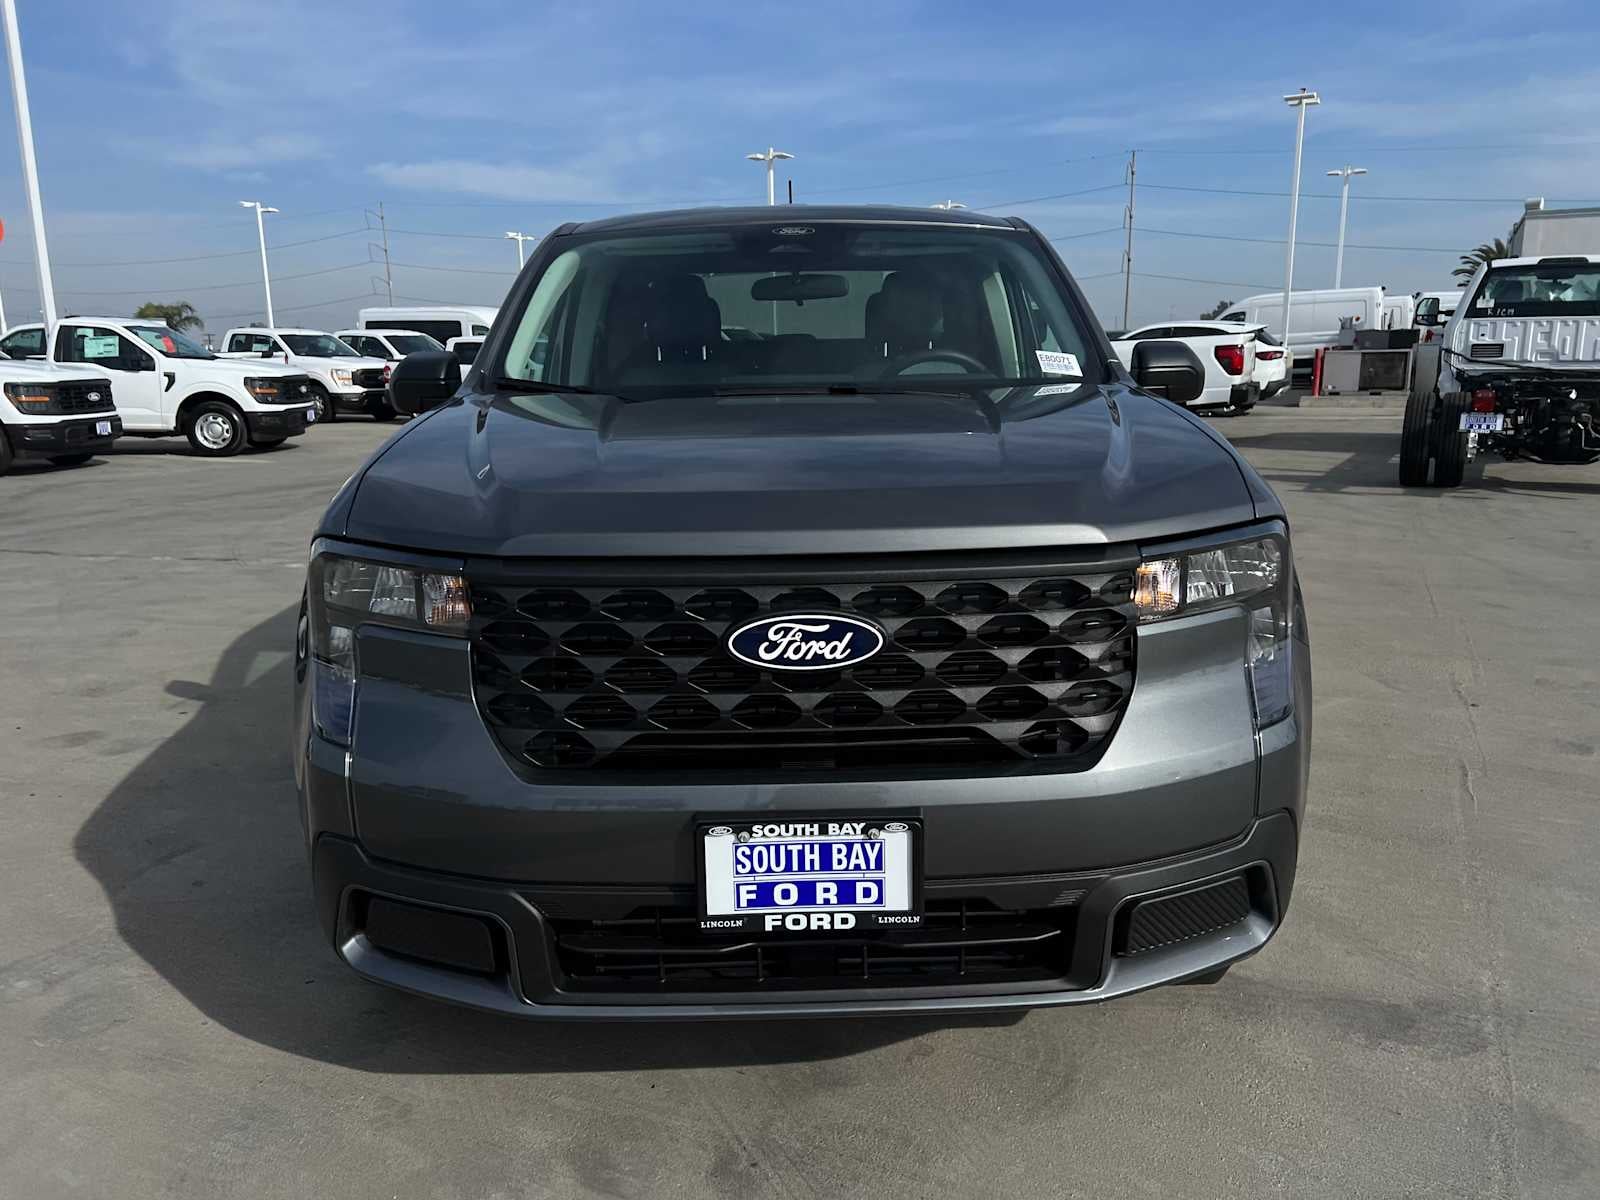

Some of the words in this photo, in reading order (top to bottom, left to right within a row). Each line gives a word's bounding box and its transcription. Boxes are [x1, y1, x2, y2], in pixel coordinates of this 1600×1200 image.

[758, 622, 854, 661] Ford
[752, 823, 819, 837] SOUTH
[828, 822, 867, 836] BAY
[736, 844, 820, 874] SOUTH
[832, 842, 881, 871] BAY
[739, 881, 880, 907] FORD
[700, 919, 743, 929] LINCOLN
[764, 912, 857, 932] FORD
[878, 915, 921, 924] LINCOLN
